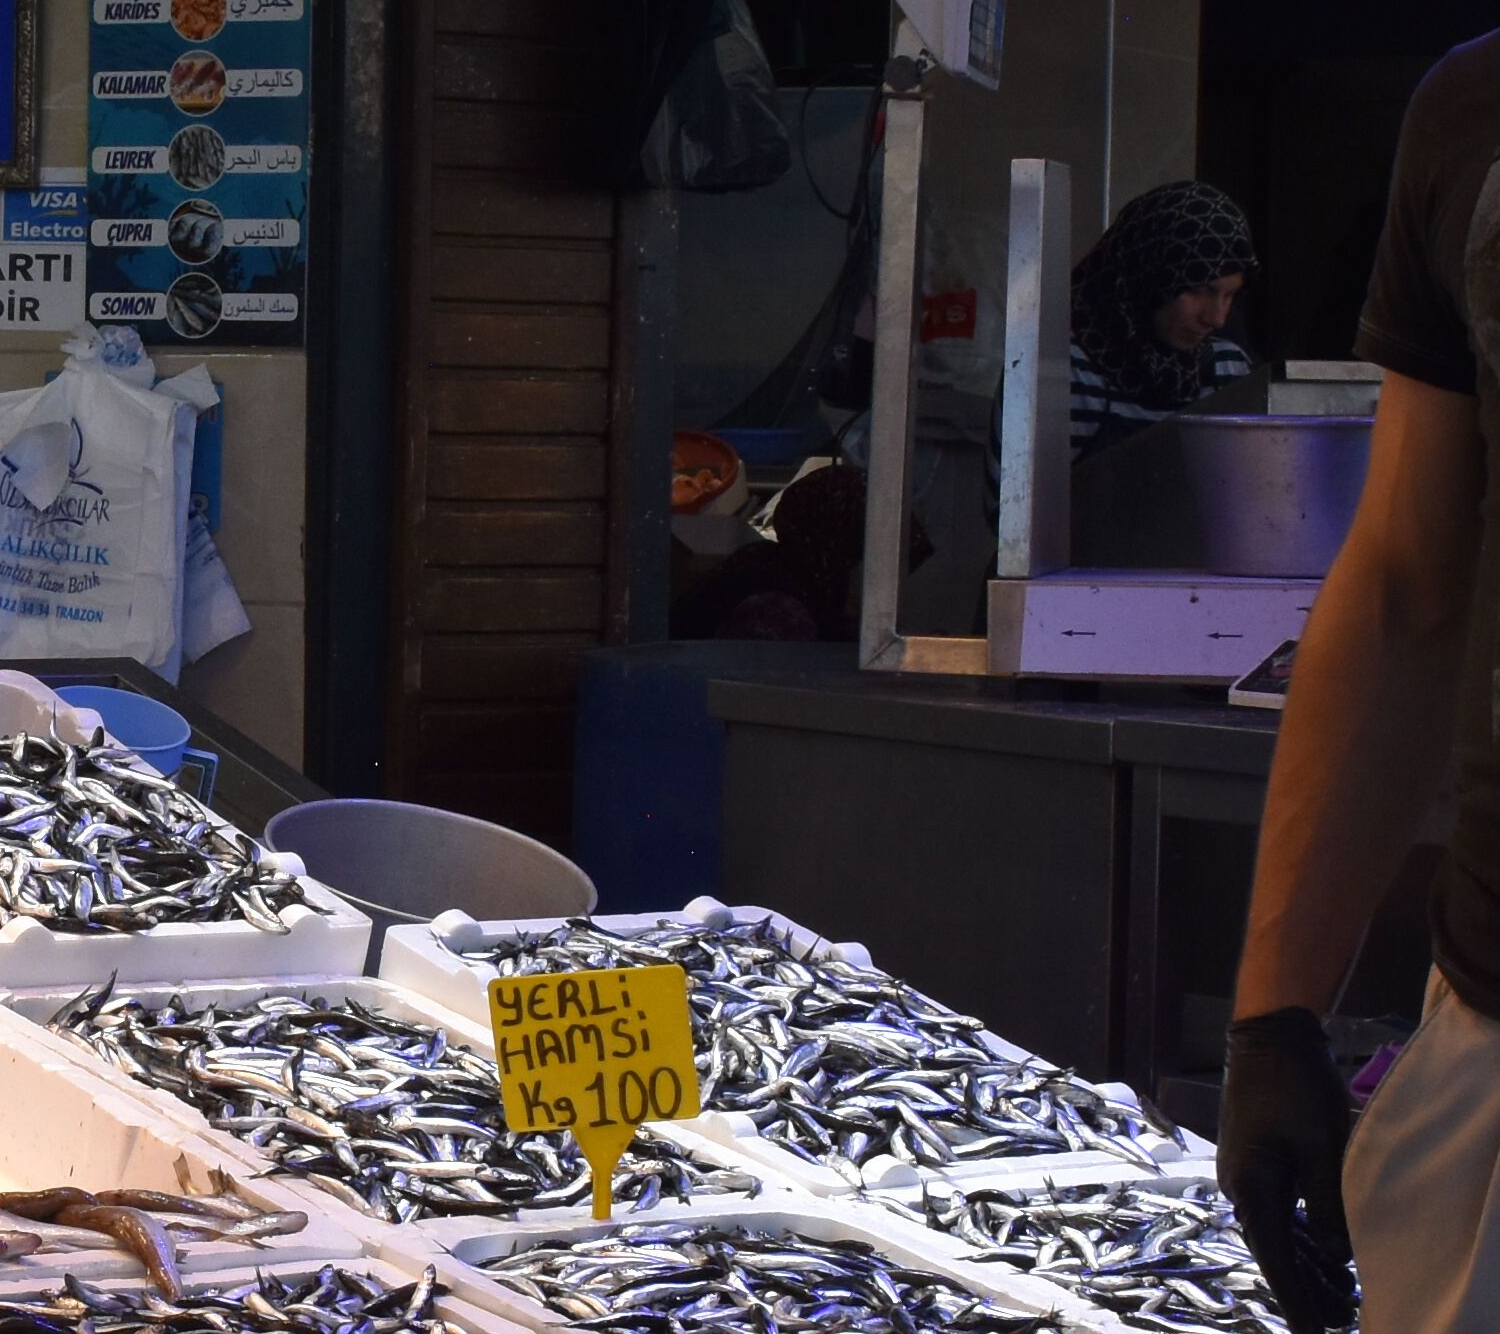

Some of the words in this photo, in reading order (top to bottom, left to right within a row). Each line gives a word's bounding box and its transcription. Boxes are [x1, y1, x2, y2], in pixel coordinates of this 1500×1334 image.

[98, 75, 167, 95] KALAMAR
[105, 150, 158, 170] LEVREK
[29, 191, 78, 208] VISA
[10, 221, 86, 238] Electro
[107, 223, 154, 247] ÇUPRA
[101, 296, 156, 317] SOMON
[56, 605, 105, 623] TRABZON
[518, 1079, 578, 1127] Kg
[585, 1067, 682, 1128] 100
